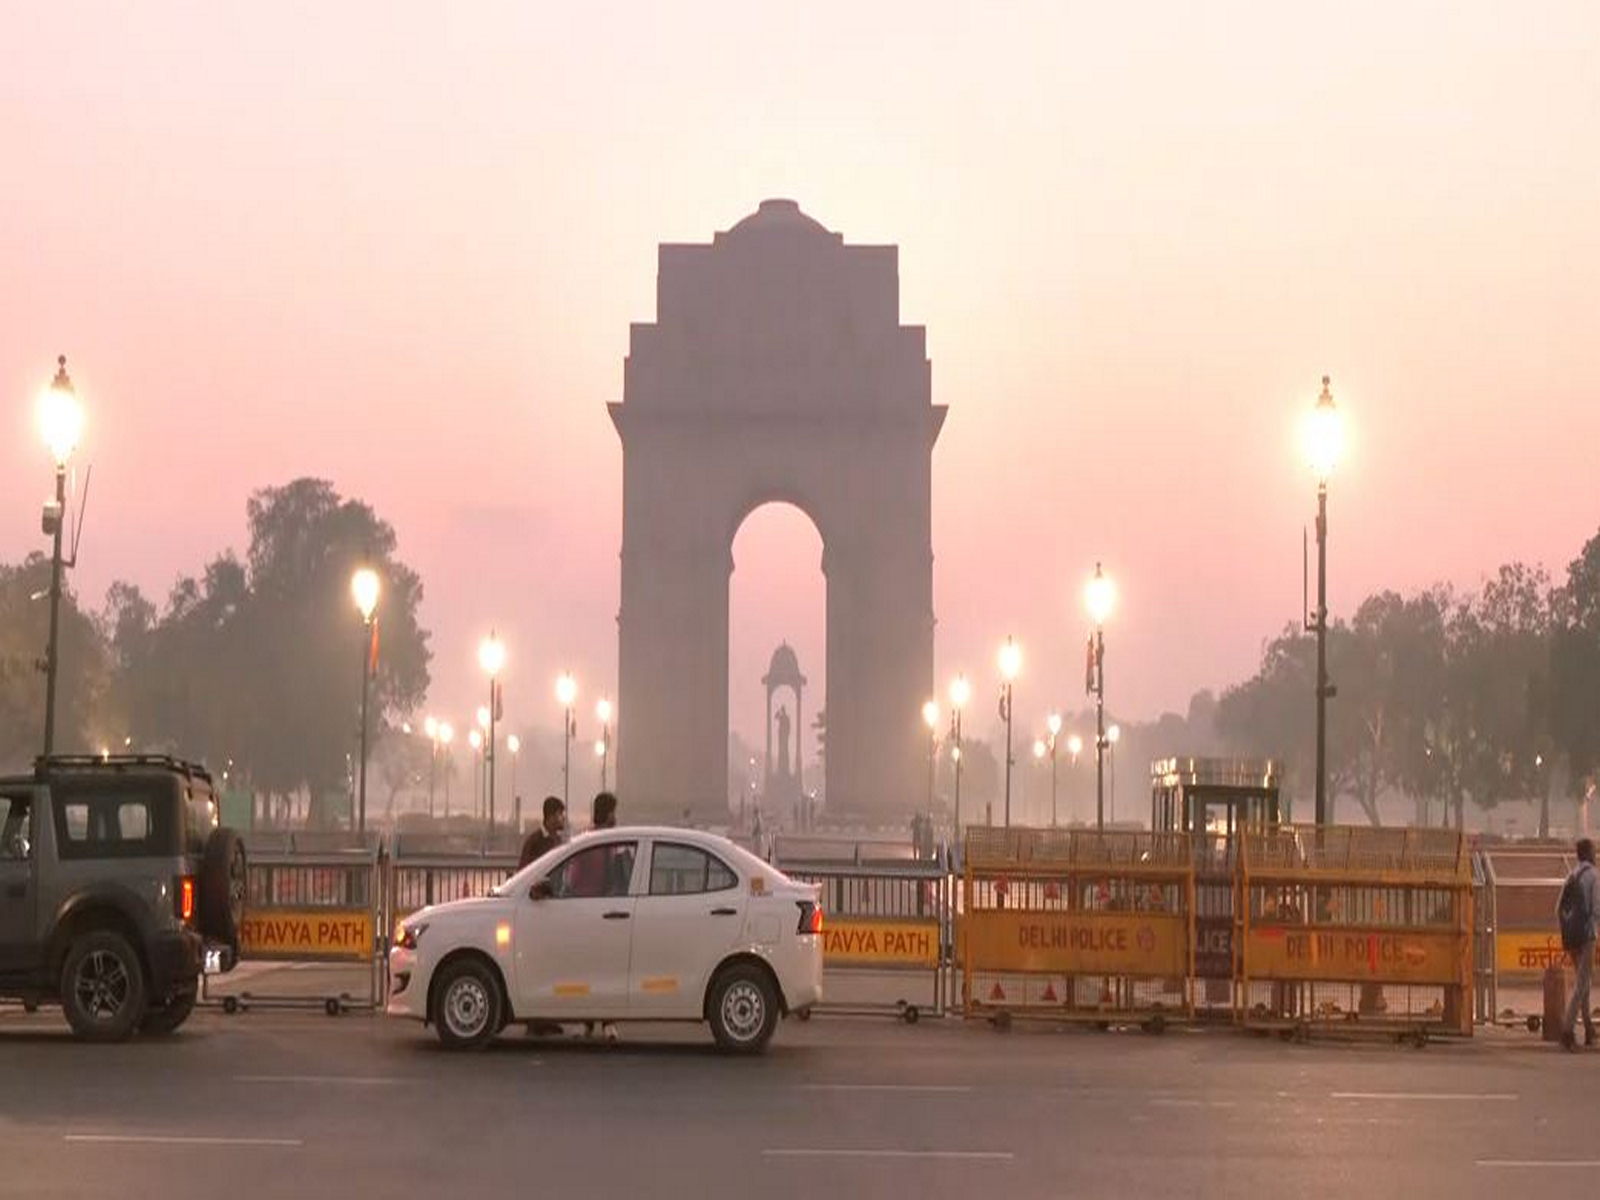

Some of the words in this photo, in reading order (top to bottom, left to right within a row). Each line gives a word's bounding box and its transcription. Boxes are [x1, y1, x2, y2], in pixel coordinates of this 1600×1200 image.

[318, 921, 365, 945] PATH
[883, 931, 930, 953] PATH
[1019, 925, 1067, 949] DELHI
[1069, 926, 1128, 952] POLICE
[1197, 930, 1229, 953] ICE
